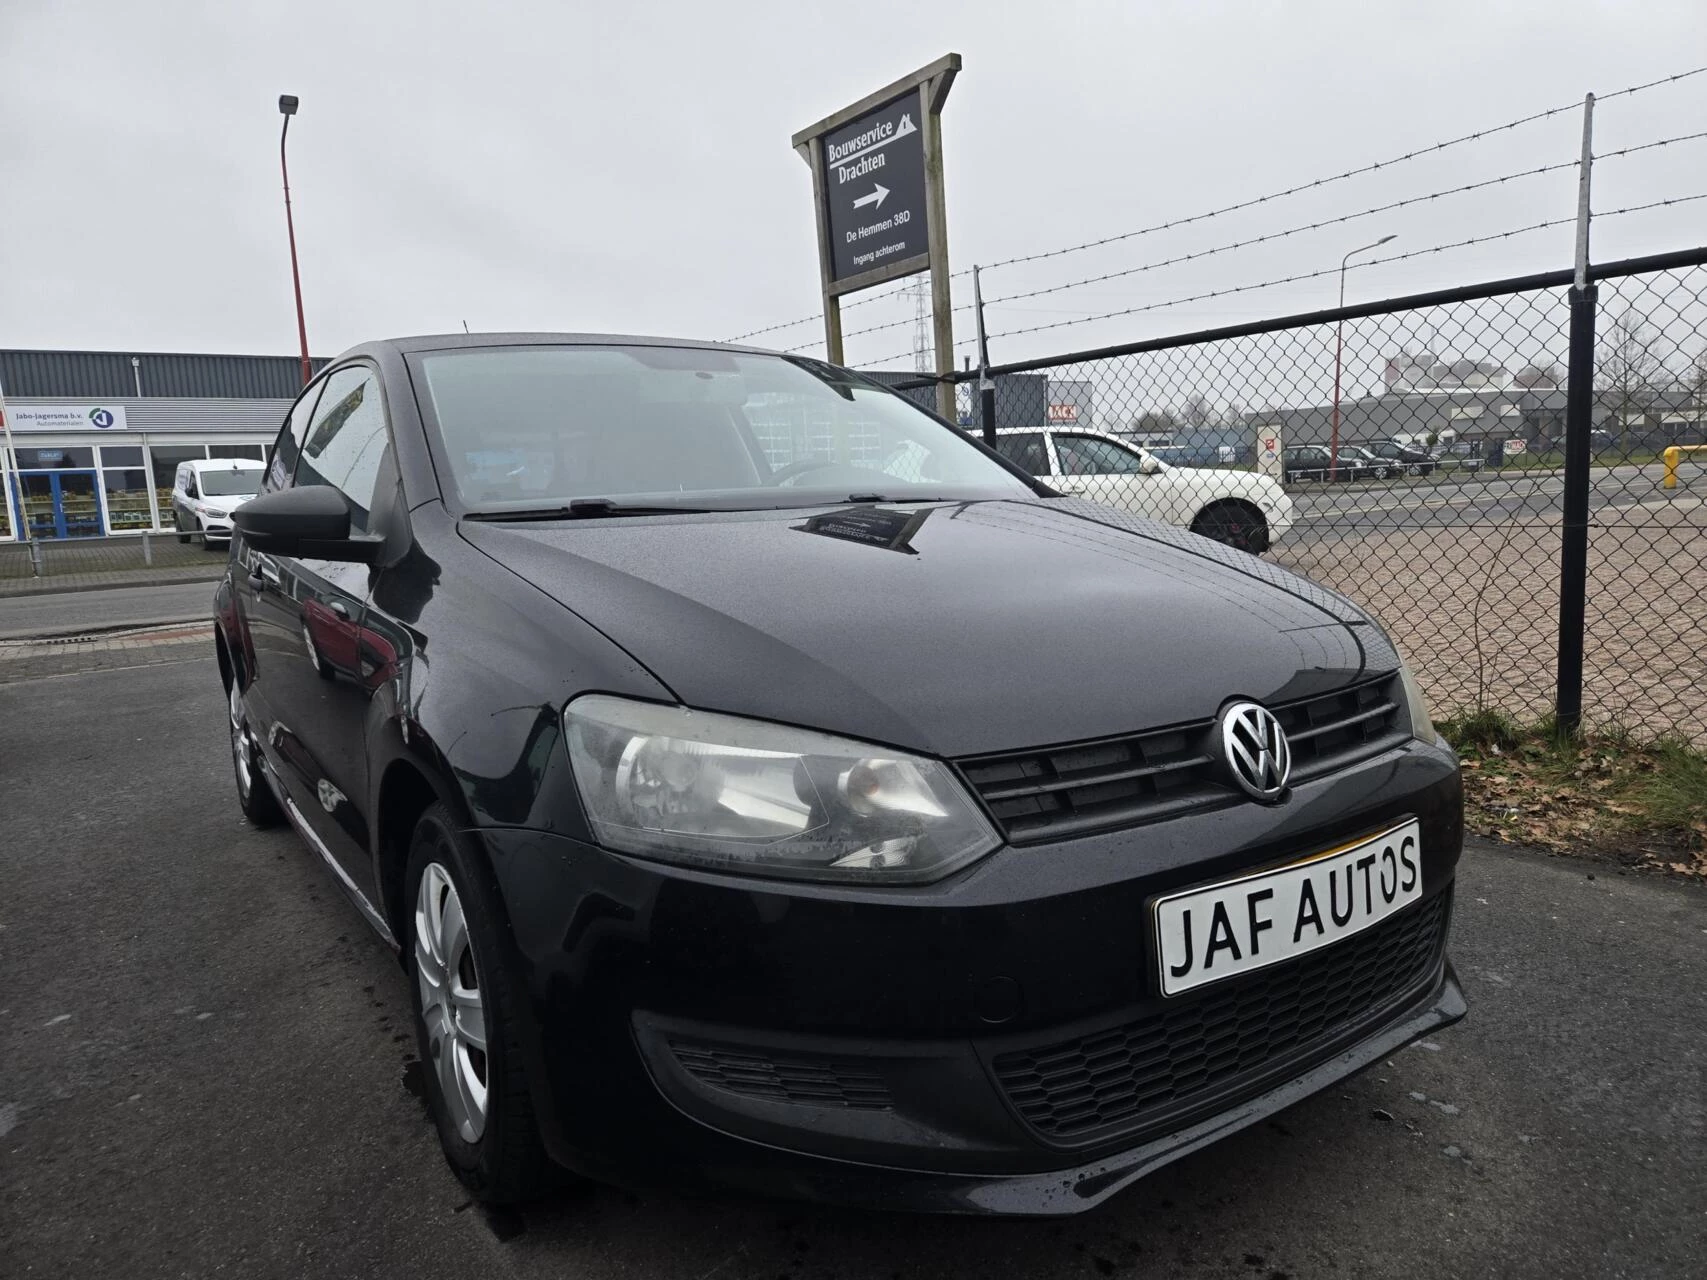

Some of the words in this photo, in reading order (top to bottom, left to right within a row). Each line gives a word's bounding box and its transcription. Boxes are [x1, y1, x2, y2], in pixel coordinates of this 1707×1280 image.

[828, 121, 894, 162] Bouwservice
[838, 153, 886, 184] Drachten
[846, 231, 857, 243] De
[858, 219, 893, 239] Hemmen
[893, 210, 911, 226] 38D
[853, 252, 875, 265] Ingang
[875, 241, 906, 258] achterom
[1171, 888, 1273, 977] JAF
[1293, 836, 1416, 943] AUTOS
